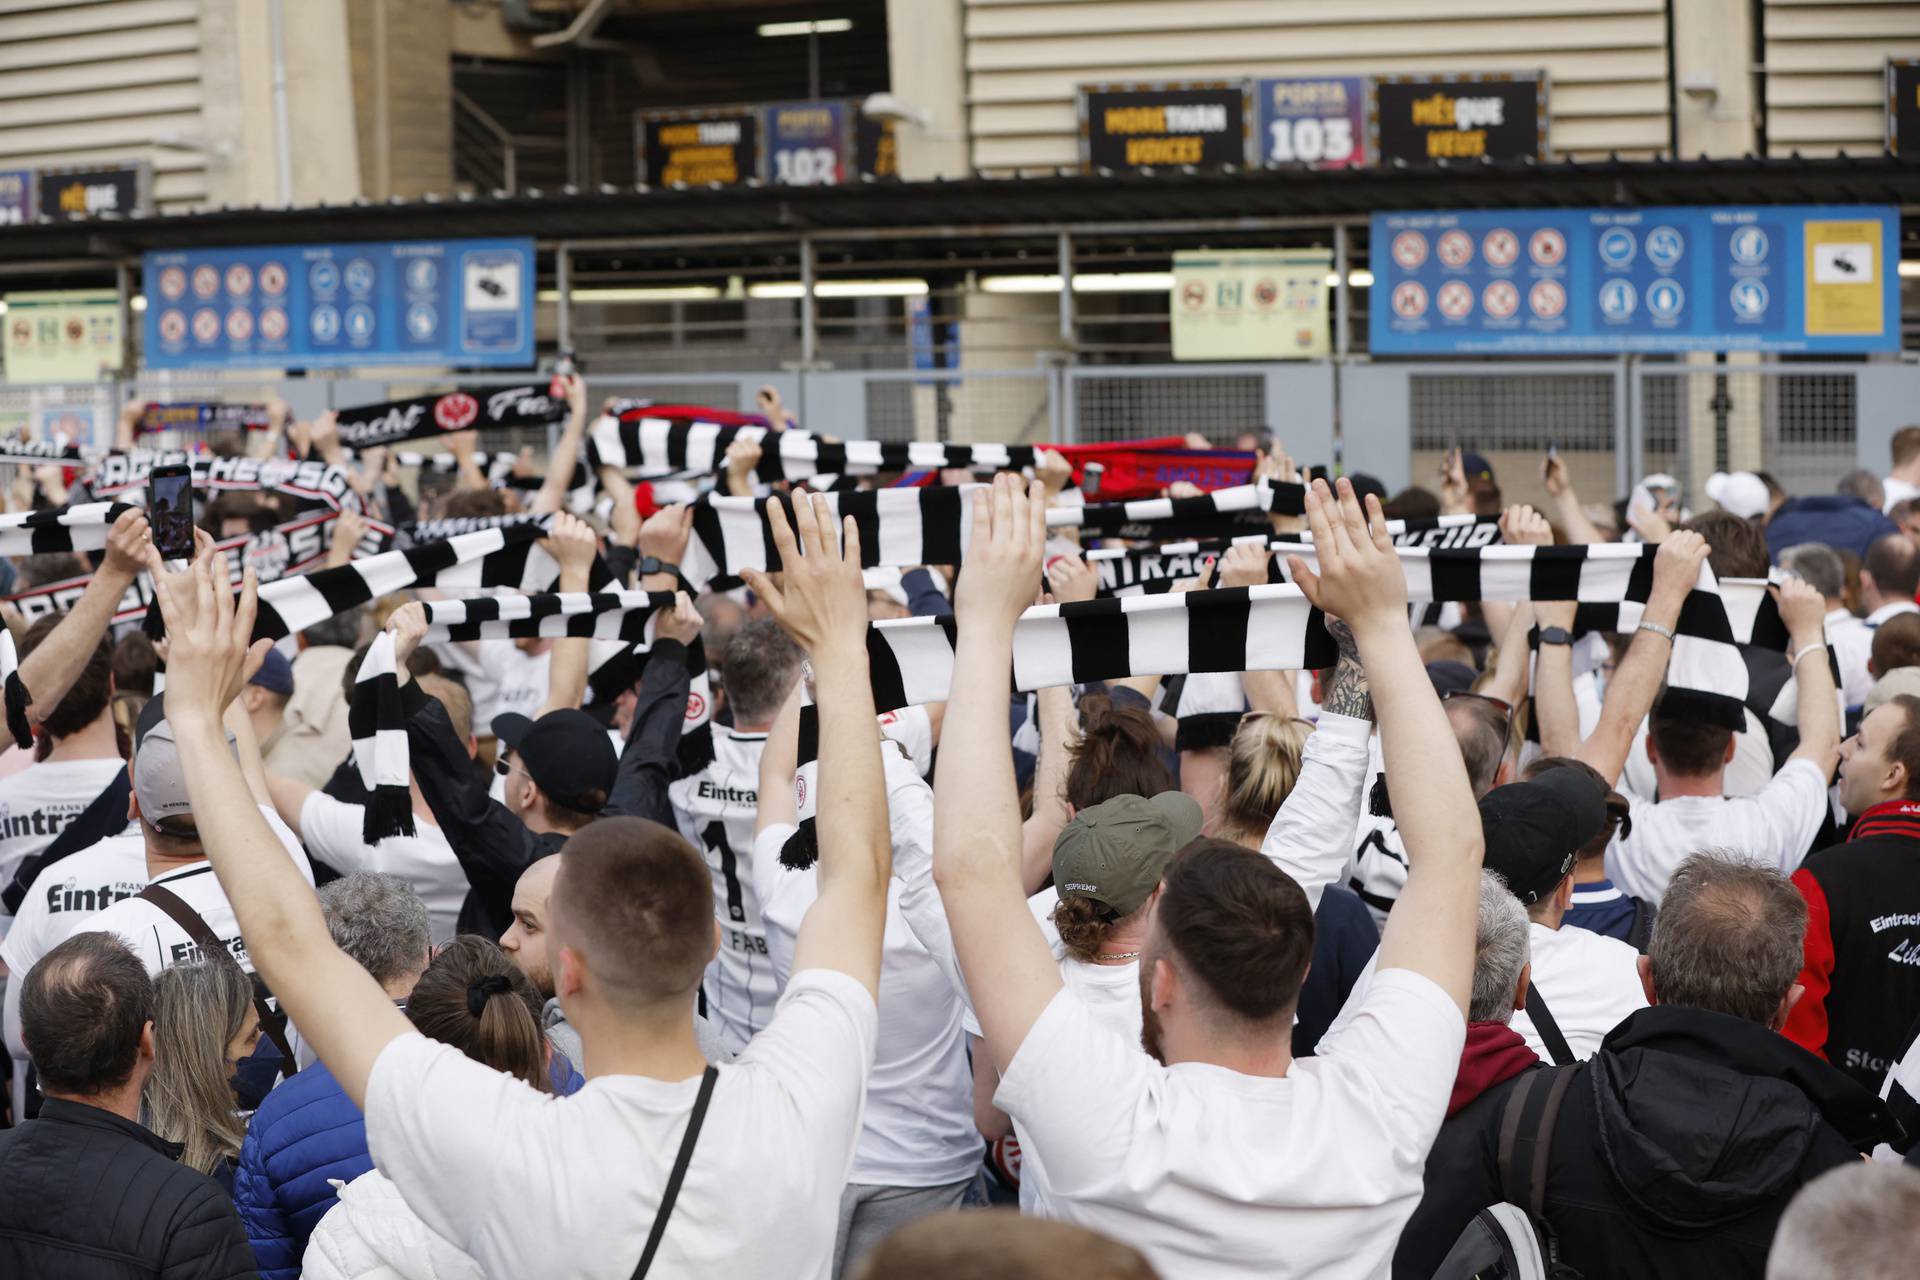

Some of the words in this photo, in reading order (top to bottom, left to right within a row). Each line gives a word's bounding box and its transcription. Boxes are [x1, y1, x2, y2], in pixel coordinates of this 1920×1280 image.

[1269, 119, 1353, 162] 103
[776, 147, 839, 186] 102
[698, 780, 757, 803] Eintra
